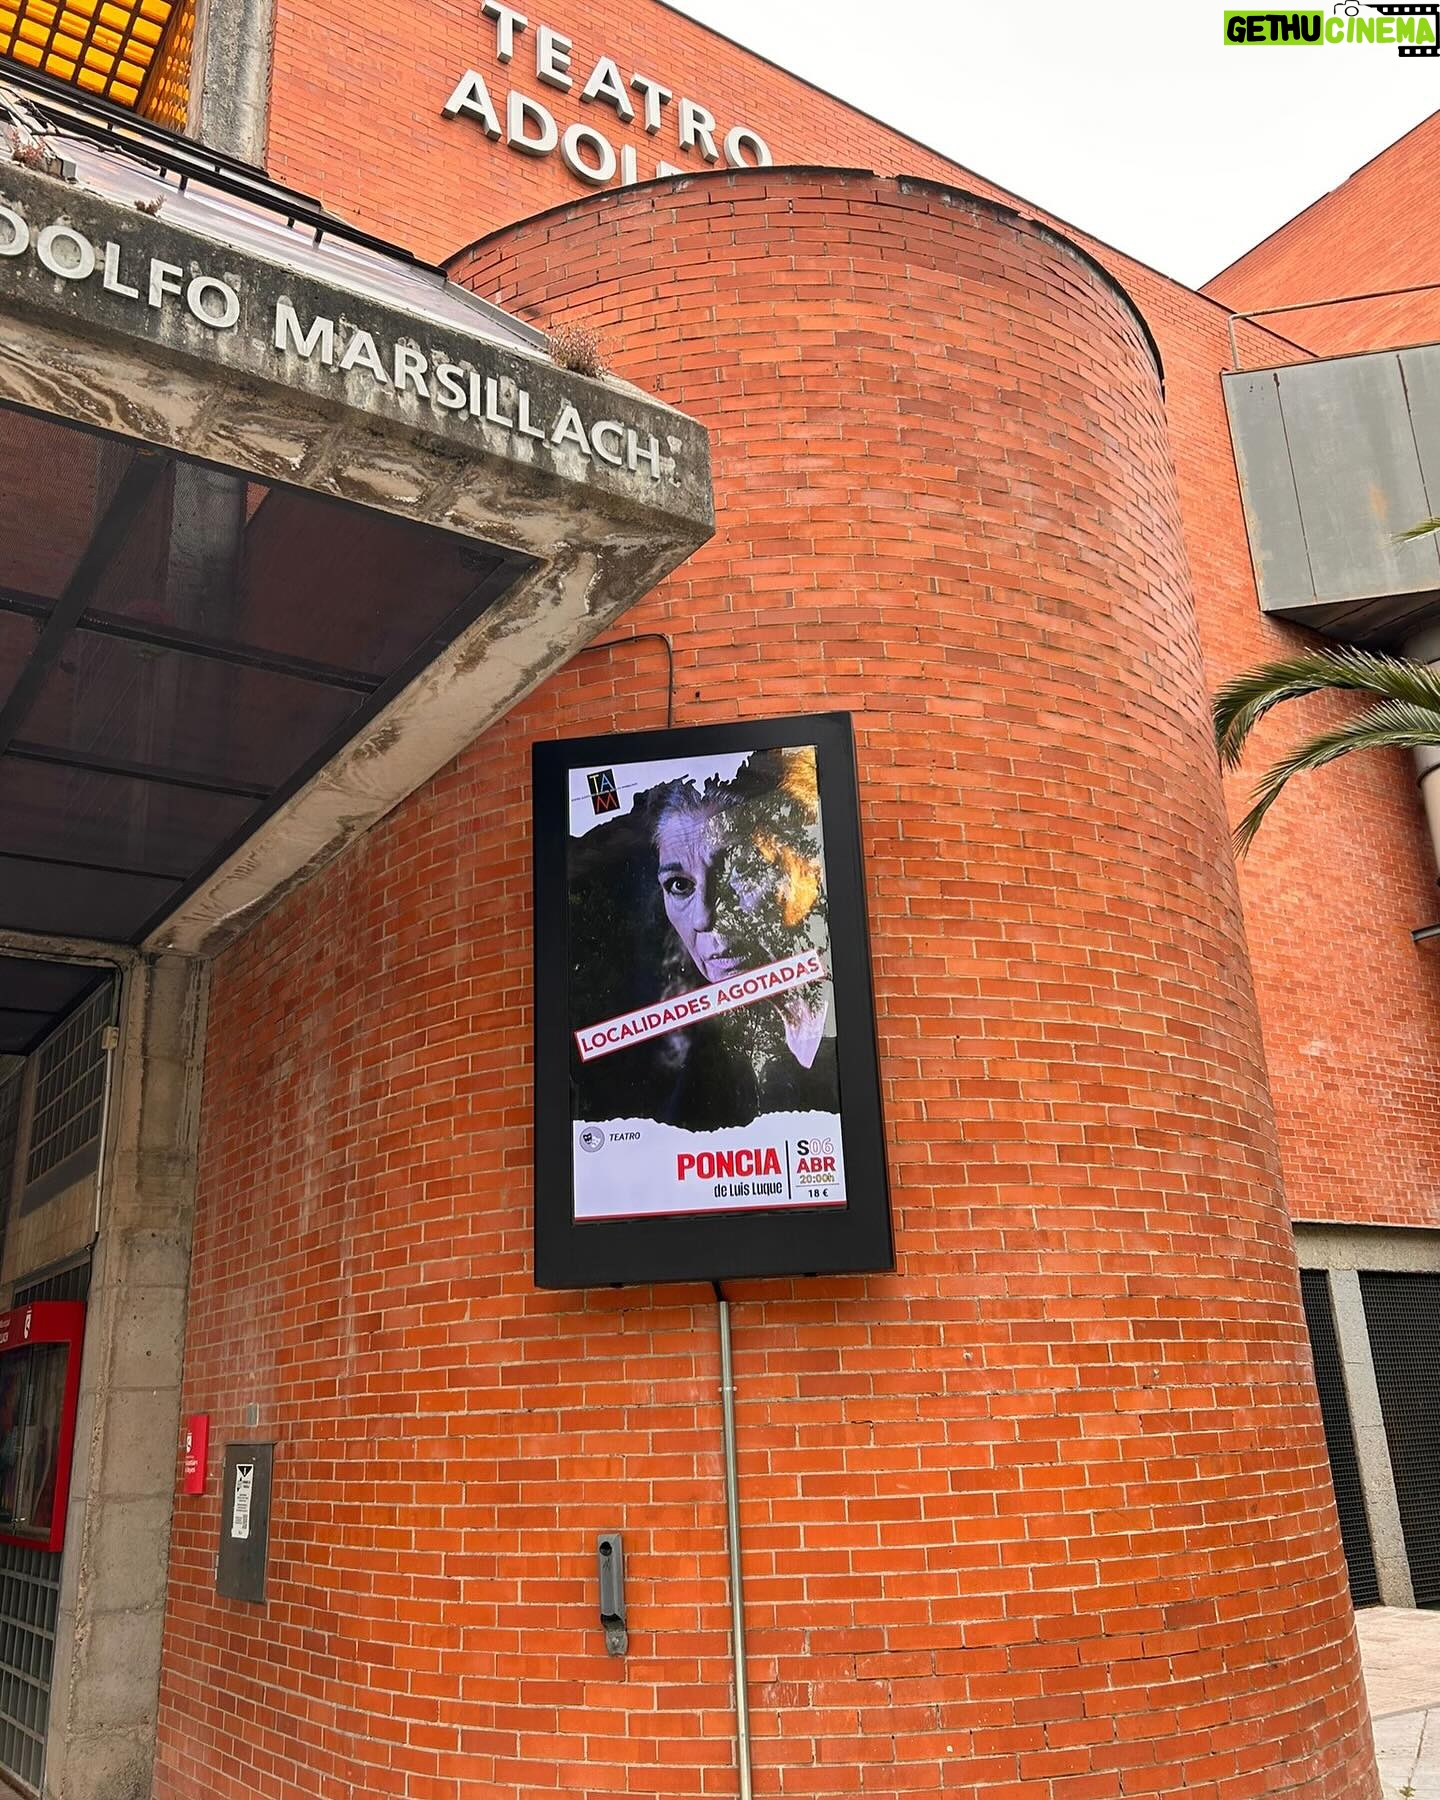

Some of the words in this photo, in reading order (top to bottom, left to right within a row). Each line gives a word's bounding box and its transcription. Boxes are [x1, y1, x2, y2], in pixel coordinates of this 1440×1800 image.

[481, 0, 773, 167] TEATRO
[441, 69, 685, 187] ADOL
[275, 301, 660, 480] MARSILLACH
[581, 994, 711, 1052] LOCALIDADES
[717, 957, 820, 1005] AGOTADAS
[609, 1131, 641, 1142] TEATRO
[677, 1148, 782, 1181] PONCIA
[796, 1155, 836, 1174] ABR
[714, 1184, 727, 1198] de
[729, 1182, 750, 1197] Luis
[752, 1182, 783, 1196] Luque
[799, 1173, 835, 1184] 20:00h
[808, 1189, 820, 1198] 18
[822, 1188, 829, 1197] €
